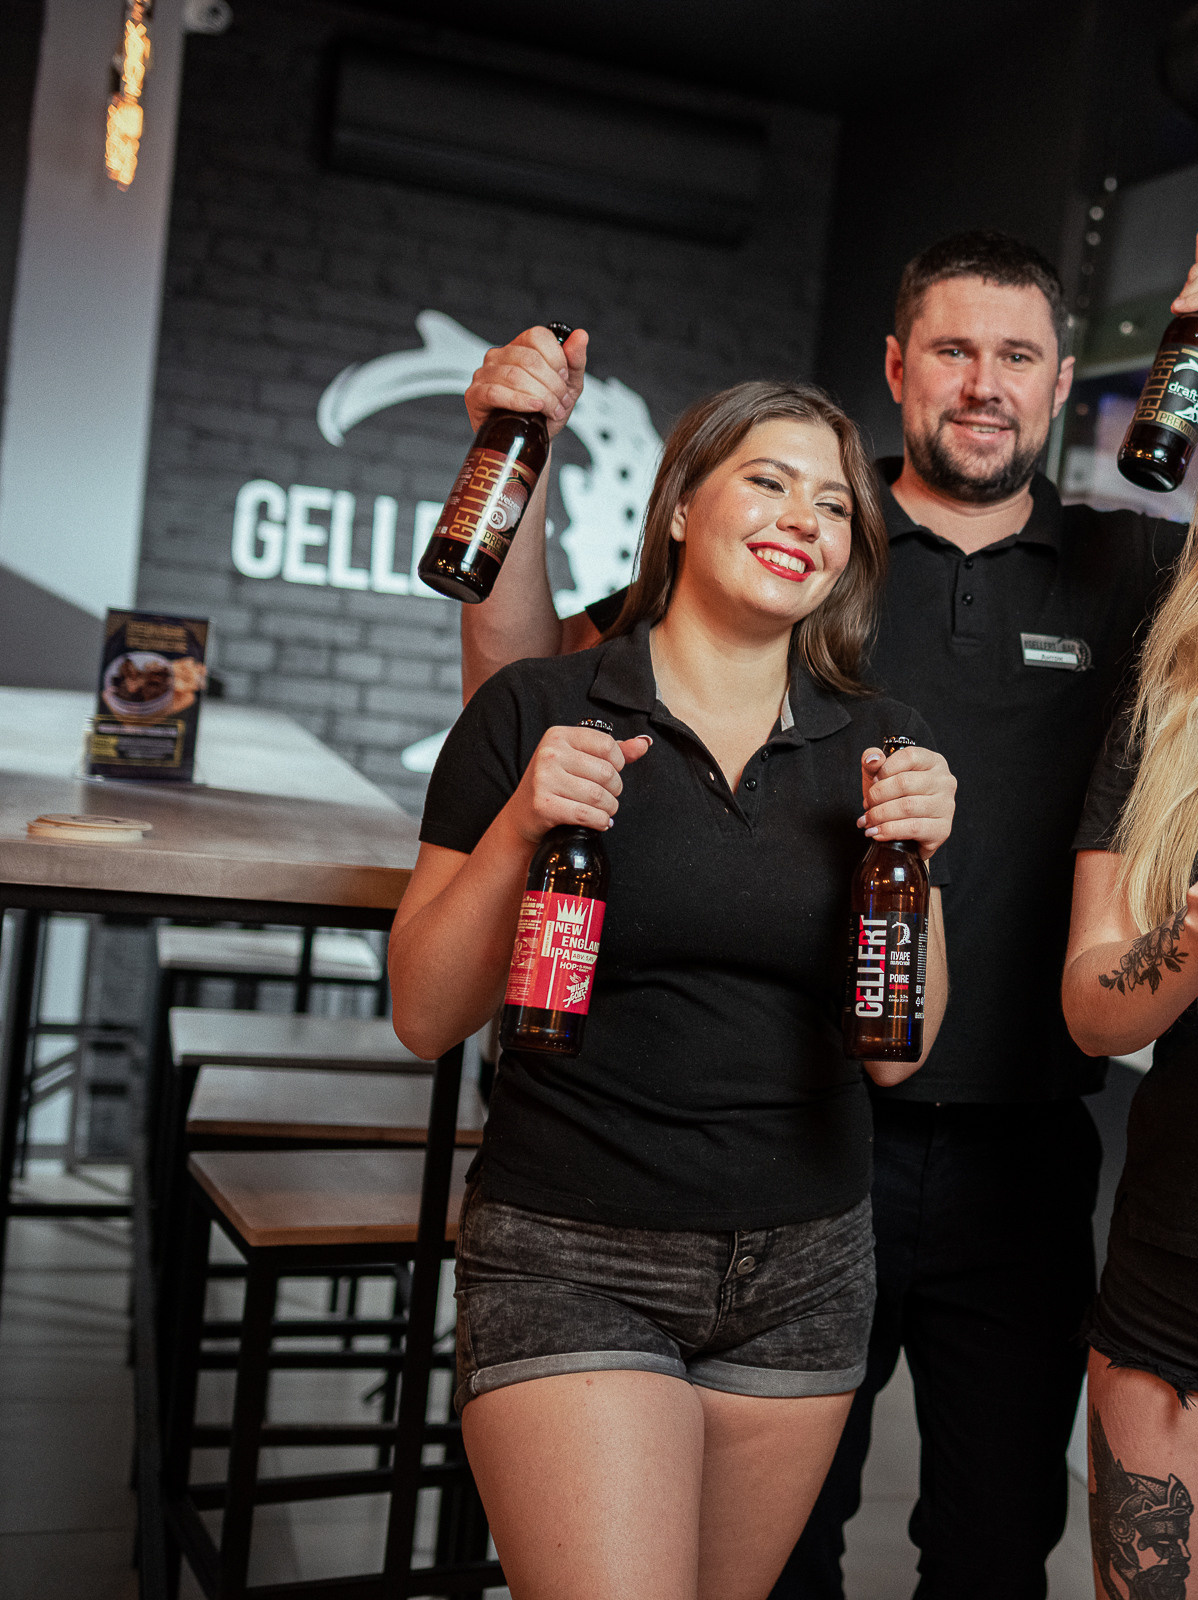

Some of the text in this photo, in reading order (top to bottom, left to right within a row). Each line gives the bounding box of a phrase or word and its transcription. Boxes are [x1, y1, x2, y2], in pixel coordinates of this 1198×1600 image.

[1135, 350, 1179, 421] GELLERT
[1168, 381, 1198, 402] draft
[449, 452, 506, 542] GELLERT
[555, 922, 583, 936] NEW
[561, 935, 600, 953] ENGLAN
[550, 947, 570, 960] IPA
[890, 951, 910, 961] ПУАРЕ
[855, 914, 888, 1018] GELLERT
[889, 973, 910, 984] POIRE
